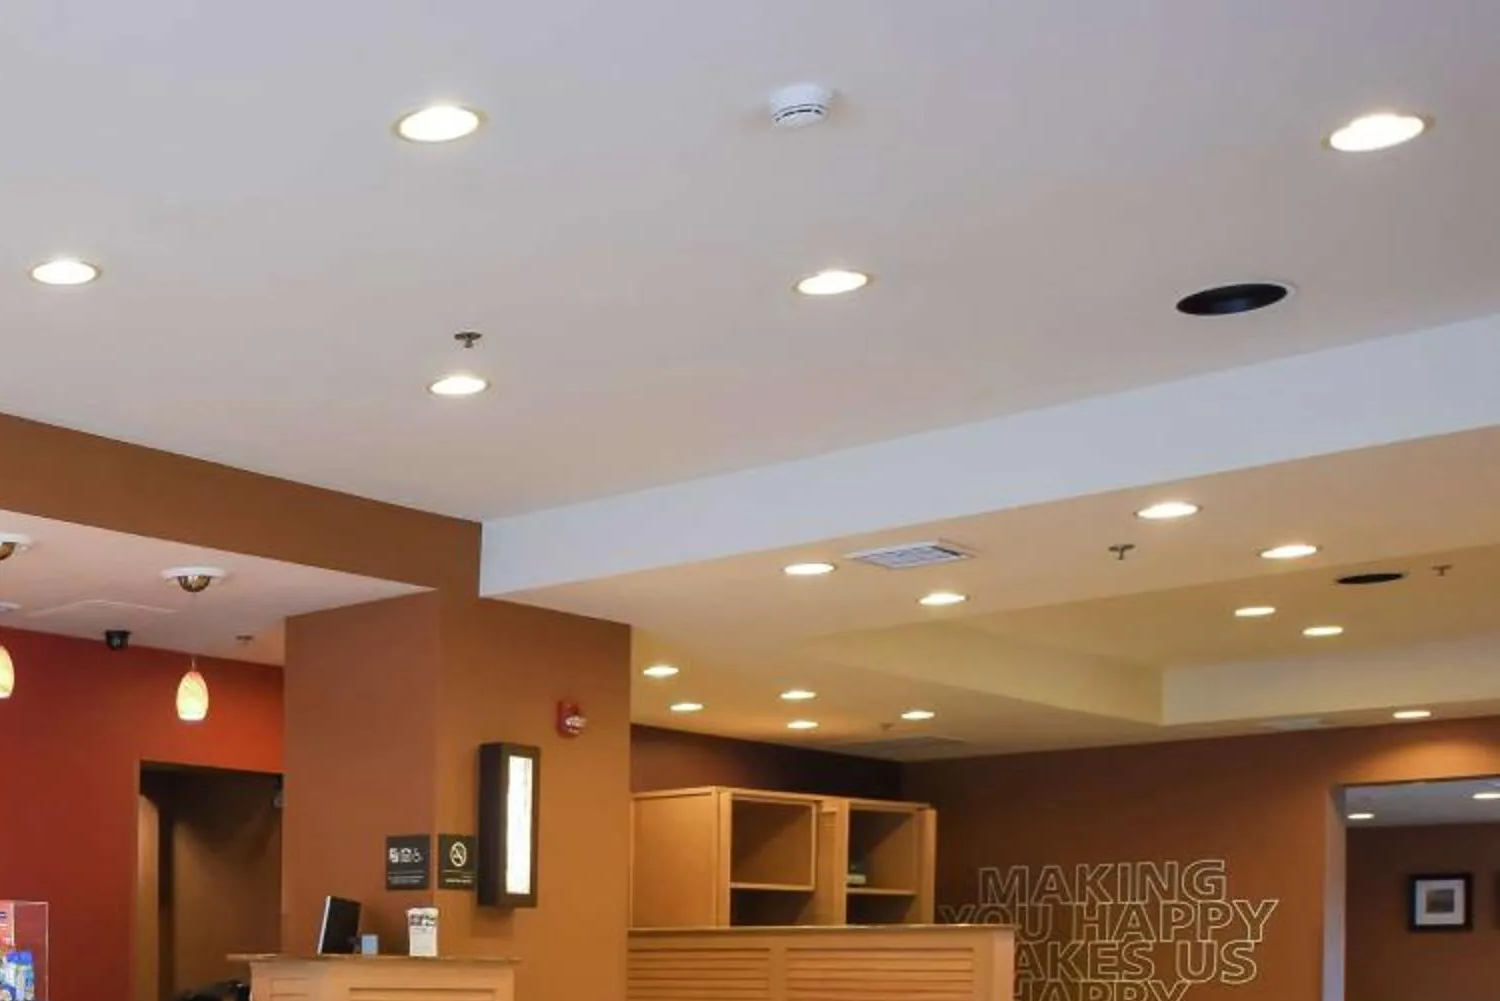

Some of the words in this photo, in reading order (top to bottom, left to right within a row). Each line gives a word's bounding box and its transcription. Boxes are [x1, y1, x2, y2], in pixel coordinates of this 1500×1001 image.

[978, 859, 1228, 906] MAKING
[1072, 899, 1279, 943] HAPPY
[1013, 940, 1156, 983] AKES
[1176, 940, 1259, 985] US
